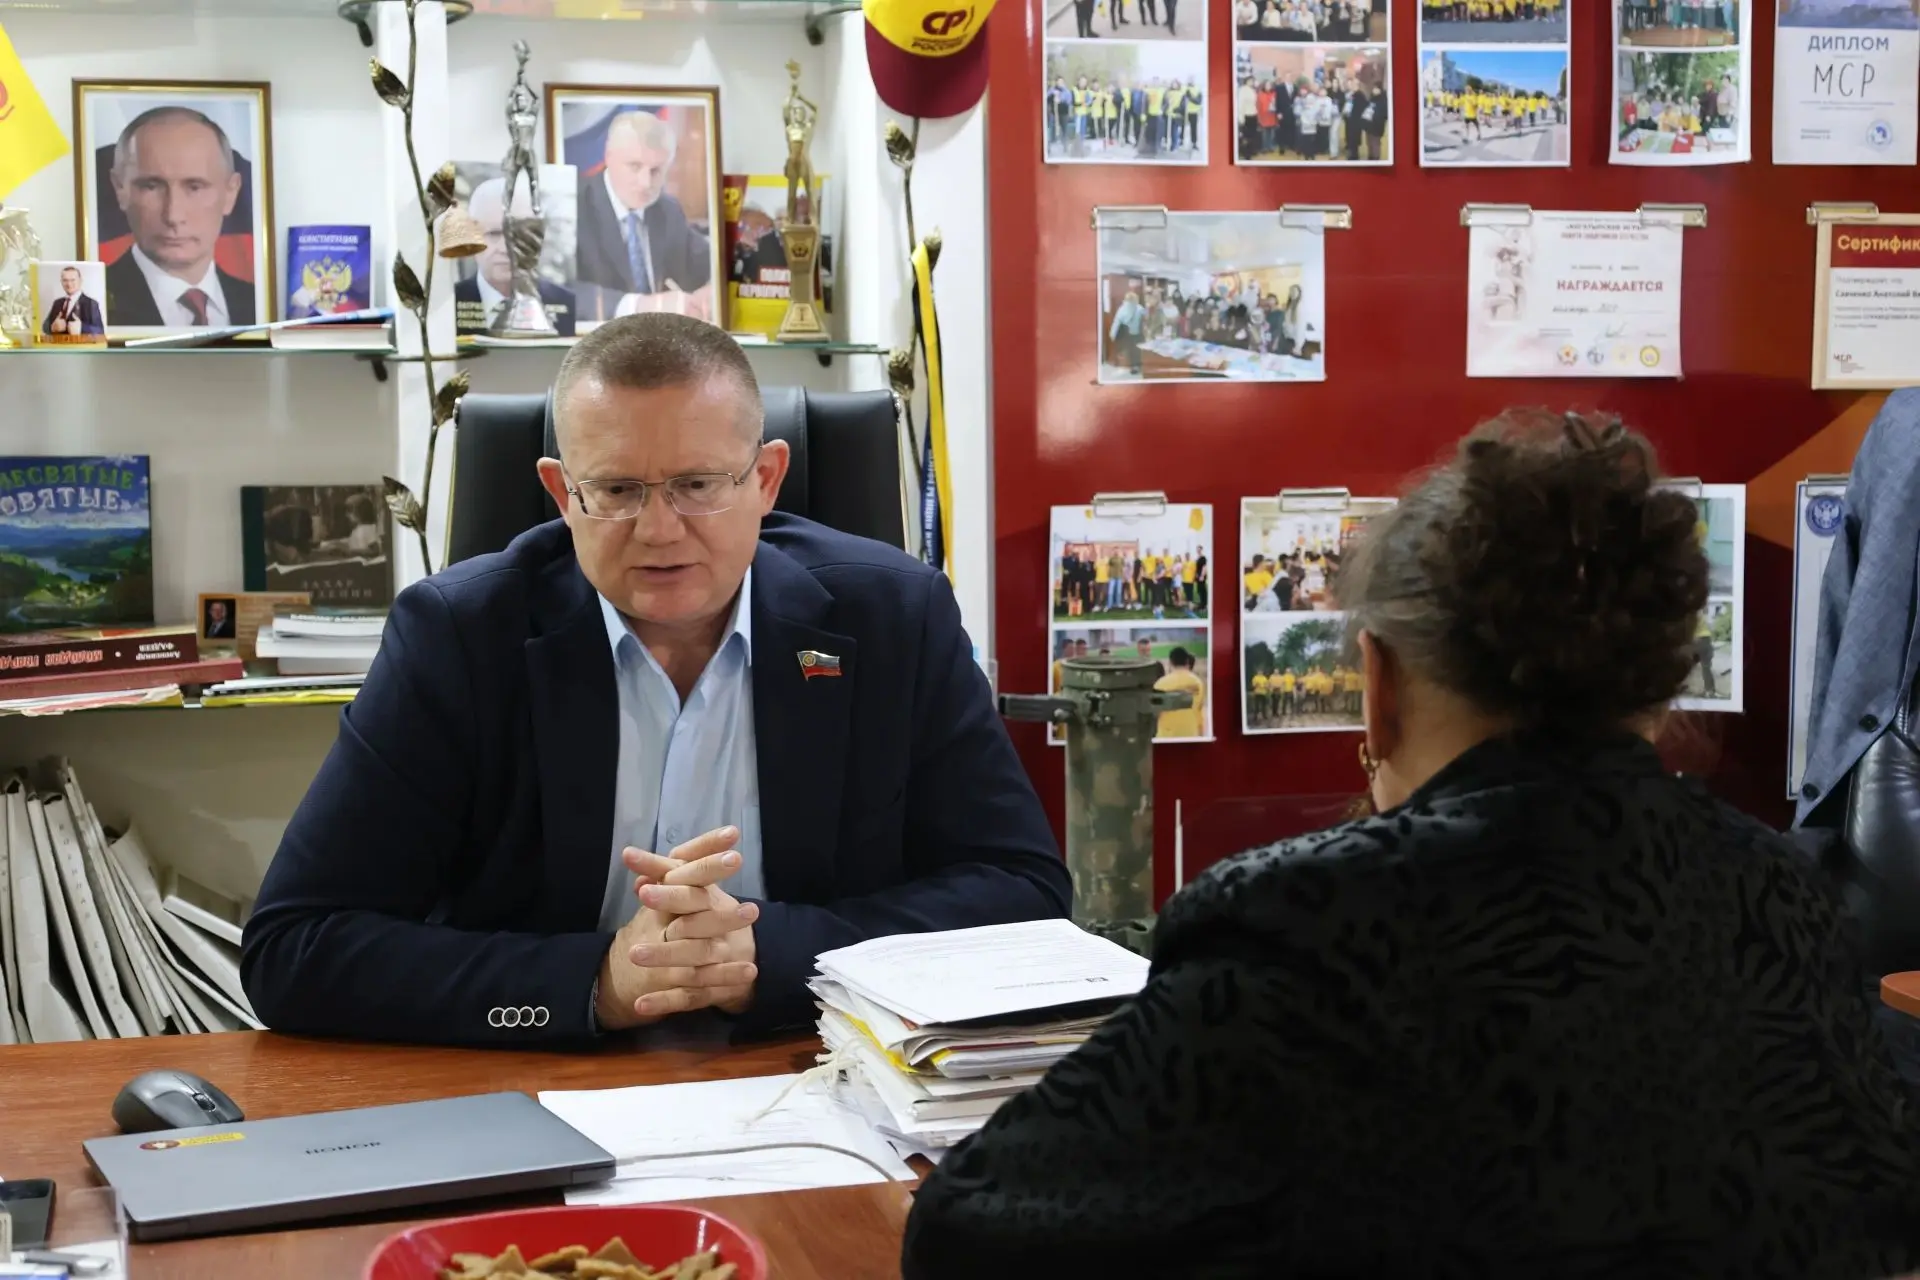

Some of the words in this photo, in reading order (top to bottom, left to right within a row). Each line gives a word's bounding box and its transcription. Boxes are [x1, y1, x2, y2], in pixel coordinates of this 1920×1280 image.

[922, 10, 967, 36] СР
[1808, 35, 1889, 52] ДИПЛОМ
[1814, 62, 1875, 97] МСР
[1557, 280, 1663, 292] НАГРАЖДАЕТСЯ
